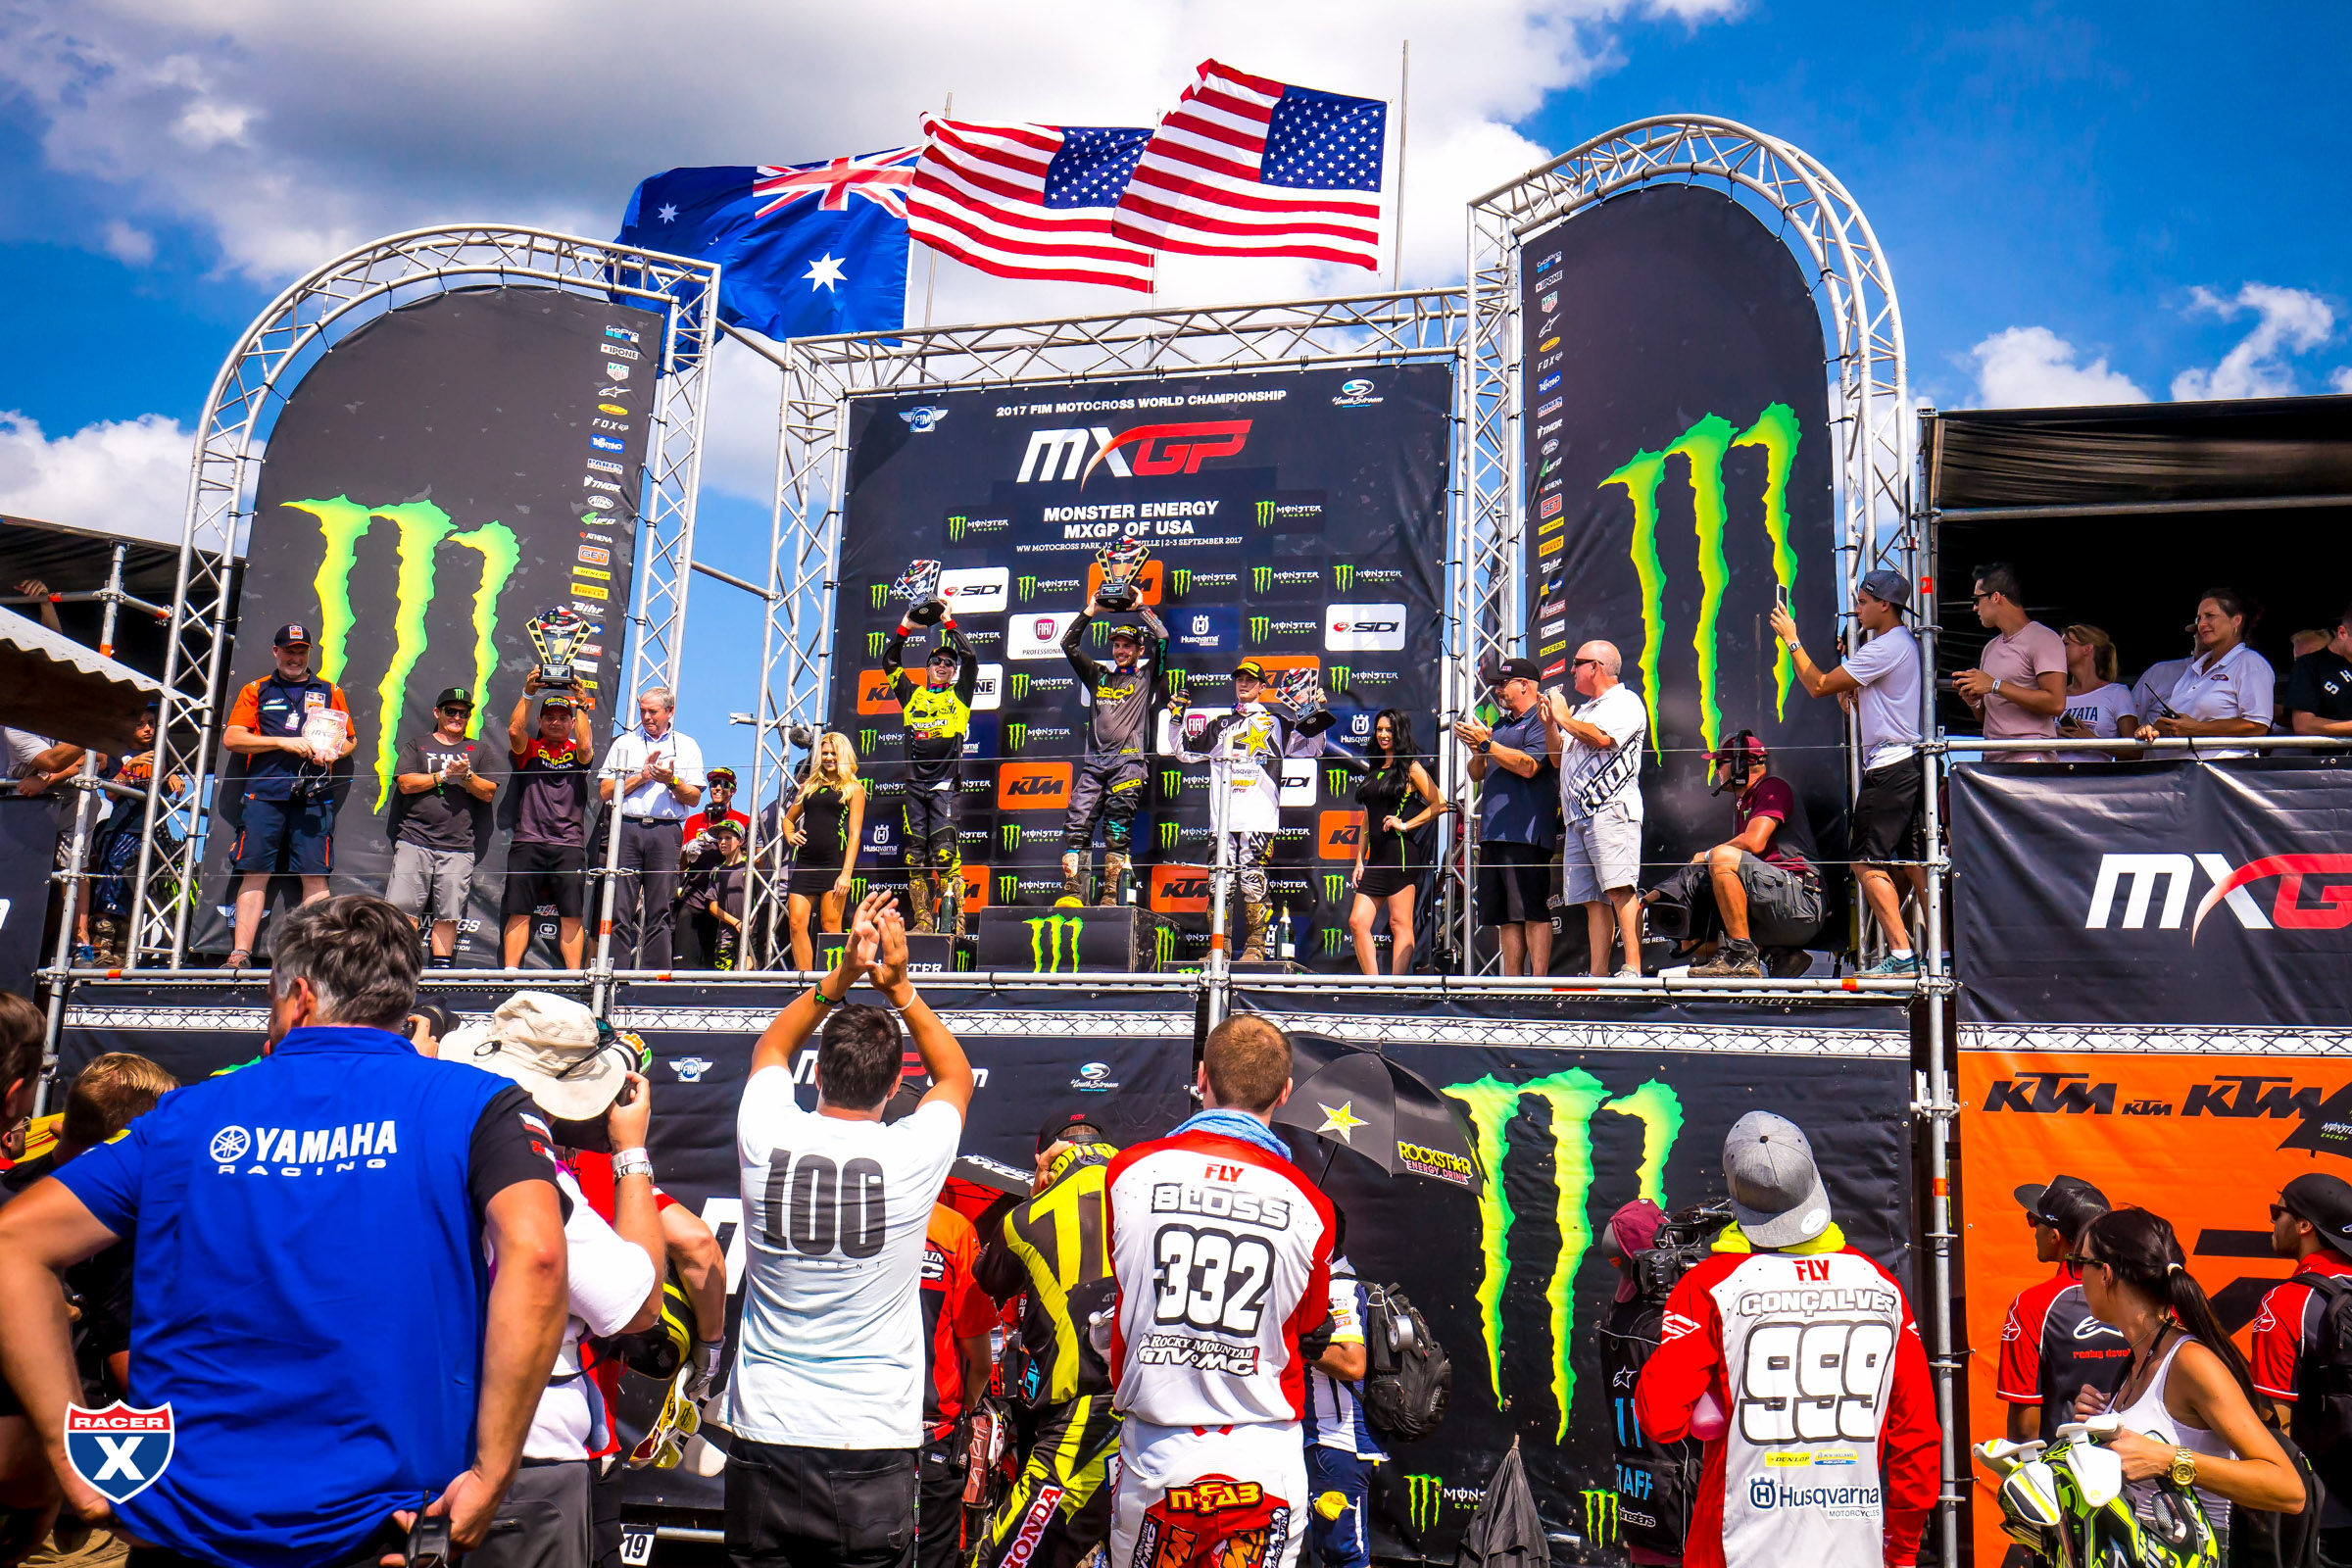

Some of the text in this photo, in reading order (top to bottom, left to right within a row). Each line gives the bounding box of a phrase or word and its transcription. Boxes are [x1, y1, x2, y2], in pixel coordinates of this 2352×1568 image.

[1542, 271, 1562, 289] IPONE
[606, 325, 640, 338] GoPro
[609, 346, 637, 359] IPONE
[1538, 355, 1555, 372] FOX
[996, 390, 1287, 417] 2017 FIM MOTOCROSS WORLD CHAMPIONSHIP
[592, 418, 617, 430] FOX
[1542, 418, 1563, 435] THOR
[1016, 419, 1253, 492] MXGP
[591, 480, 622, 493] THOR
[1544, 478, 1563, 492] ATHENA
[1043, 500, 1219, 522] MONSTER ENERGY
[1276, 505, 1322, 514] MONSTER
[1544, 499, 1560, 514] GET
[966, 518, 1009, 528] MONSTER
[1064, 519, 1195, 539] MXGP OF USA
[586, 533, 612, 544] ATHENA
[1030, 543, 1079, 552] MOTOCROSS
[1178, 537, 1224, 546] SEPTEMBER
[581, 550, 607, 562] GET
[1193, 572, 1238, 581] MONSTER
[1273, 571, 1319, 580] MONSTER
[1355, 569, 1402, 578] MONSTER
[960, 584, 1003, 596] SIDI
[1037, 579, 1080, 588] MONSTER
[1036, 622, 1054, 635] FIAT
[1271, 620, 1317, 630] MONSTER
[1352, 621, 1399, 632] SIDI
[1030, 677, 1074, 686] MONSTER
[1187, 673, 1233, 682] MONSTER
[545, 697, 569, 706] GEICO
[911, 718, 948, 729] SUZUKI
[1188, 717, 1205, 730] FIAT
[1027, 727, 1071, 736] MONSTER
[1341, 736, 1371, 745] Husqvar
[537, 749, 574, 765] GEICO
[874, 783, 906, 792] MONST
[1007, 775, 1064, 796] KTM
[1111, 778, 1142, 794] GEICO
[1278, 827, 1310, 836] NSTER
[863, 844, 898, 853] Husqvarna
[1019, 880, 1062, 890] MONSTER
[1269, 879, 1308, 889] ONSTER
[2085, 853, 2352, 949] MXG
[682, 1064, 699, 1075] FIM
[1983, 1072, 2323, 1120] KTM KTM KTM
[255, 1120, 398, 1164] YAMAHA
[1398, 1142, 1472, 1176] ROCKSTAR
[218, 1158, 387, 1177] RACING
[1203, 1163, 1244, 1184] FLY
[1406, 1159, 1468, 1184] ENERGY DRINK
[763, 1148, 886, 1259] 100
[1152, 1183, 1291, 1231] BLOSS
[1792, 1259, 1830, 1282] FLY
[1153, 1223, 1275, 1338] 332
[1151, 1334, 1255, 1359] ROCKY MOUNTAIN
[1739, 1319, 1895, 1446] 999
[1779, 1486, 1880, 1508] Husqvarna
[1829, 1509, 1881, 1518] MOTORCYCLES
